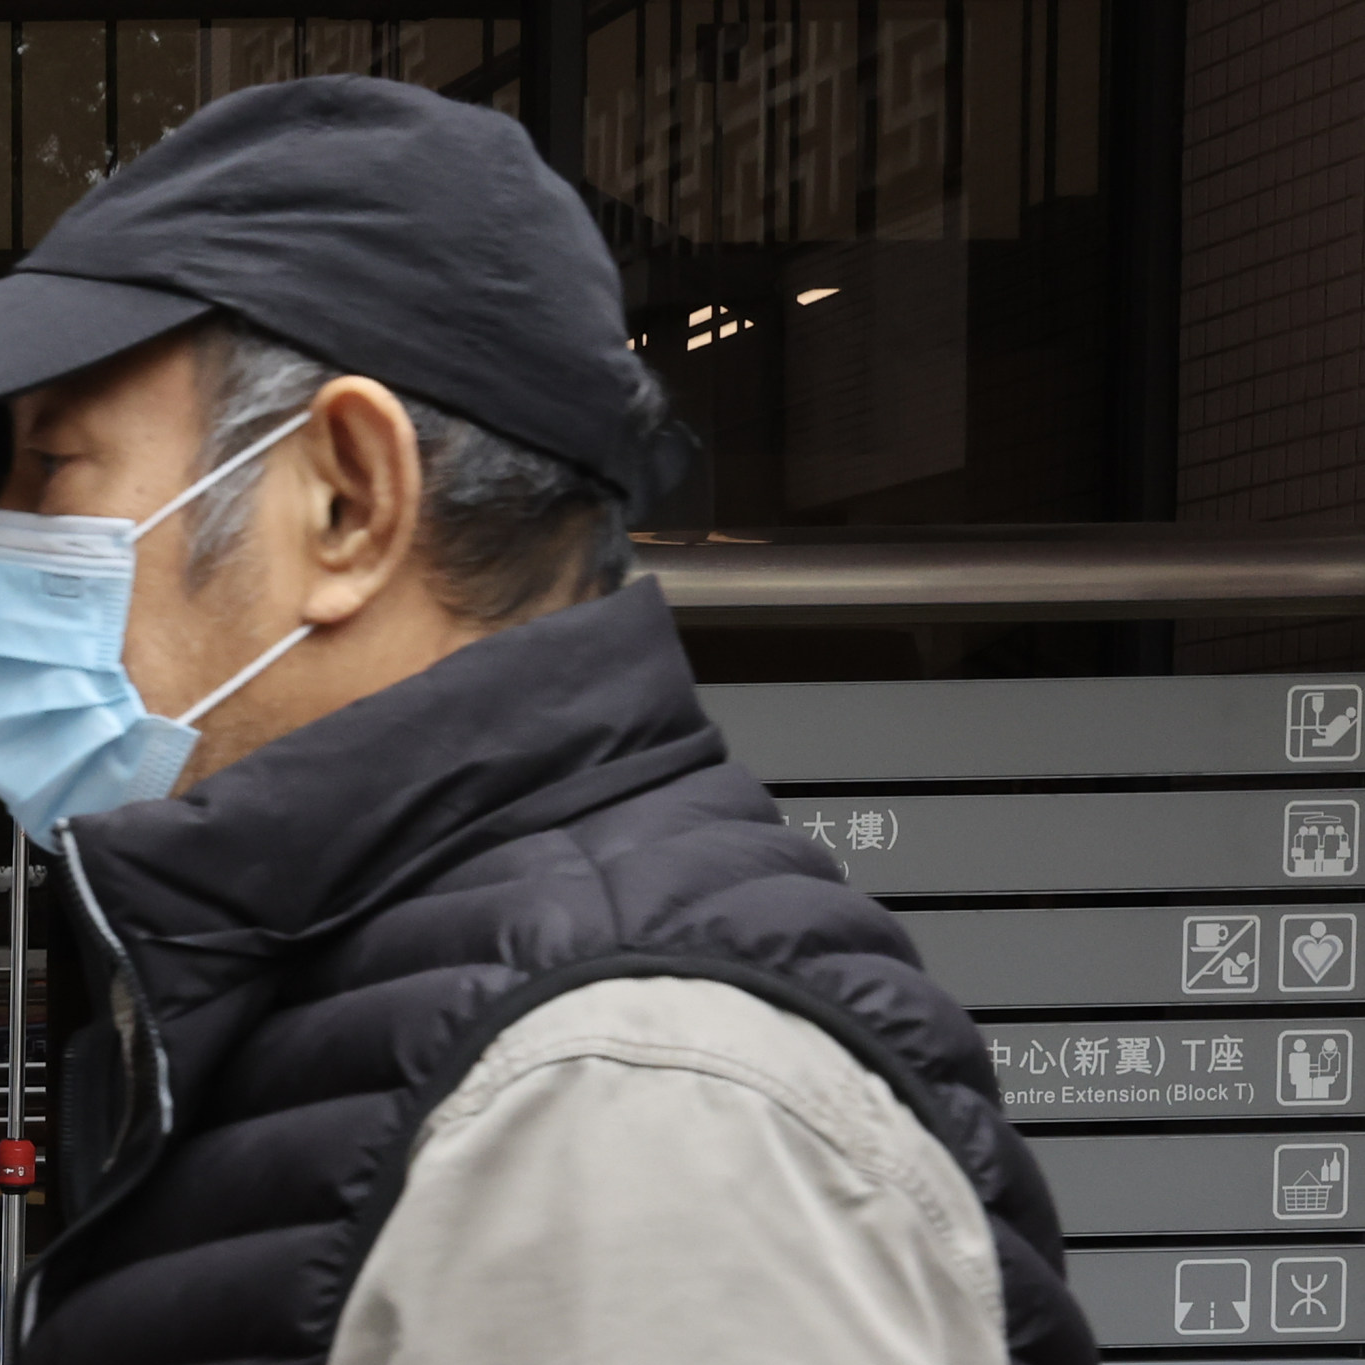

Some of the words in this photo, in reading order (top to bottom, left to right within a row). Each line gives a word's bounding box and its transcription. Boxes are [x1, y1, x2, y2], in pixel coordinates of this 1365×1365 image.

[782, 809, 898, 850] 大樓)
[1181, 1034, 1244, 1073] T座
[1003, 1088, 1056, 1104] entre
[1061, 1085, 1160, 1104] Extension
[1166, 1083, 1229, 1105] (Block
[1234, 1083, 1255, 1104] T)
